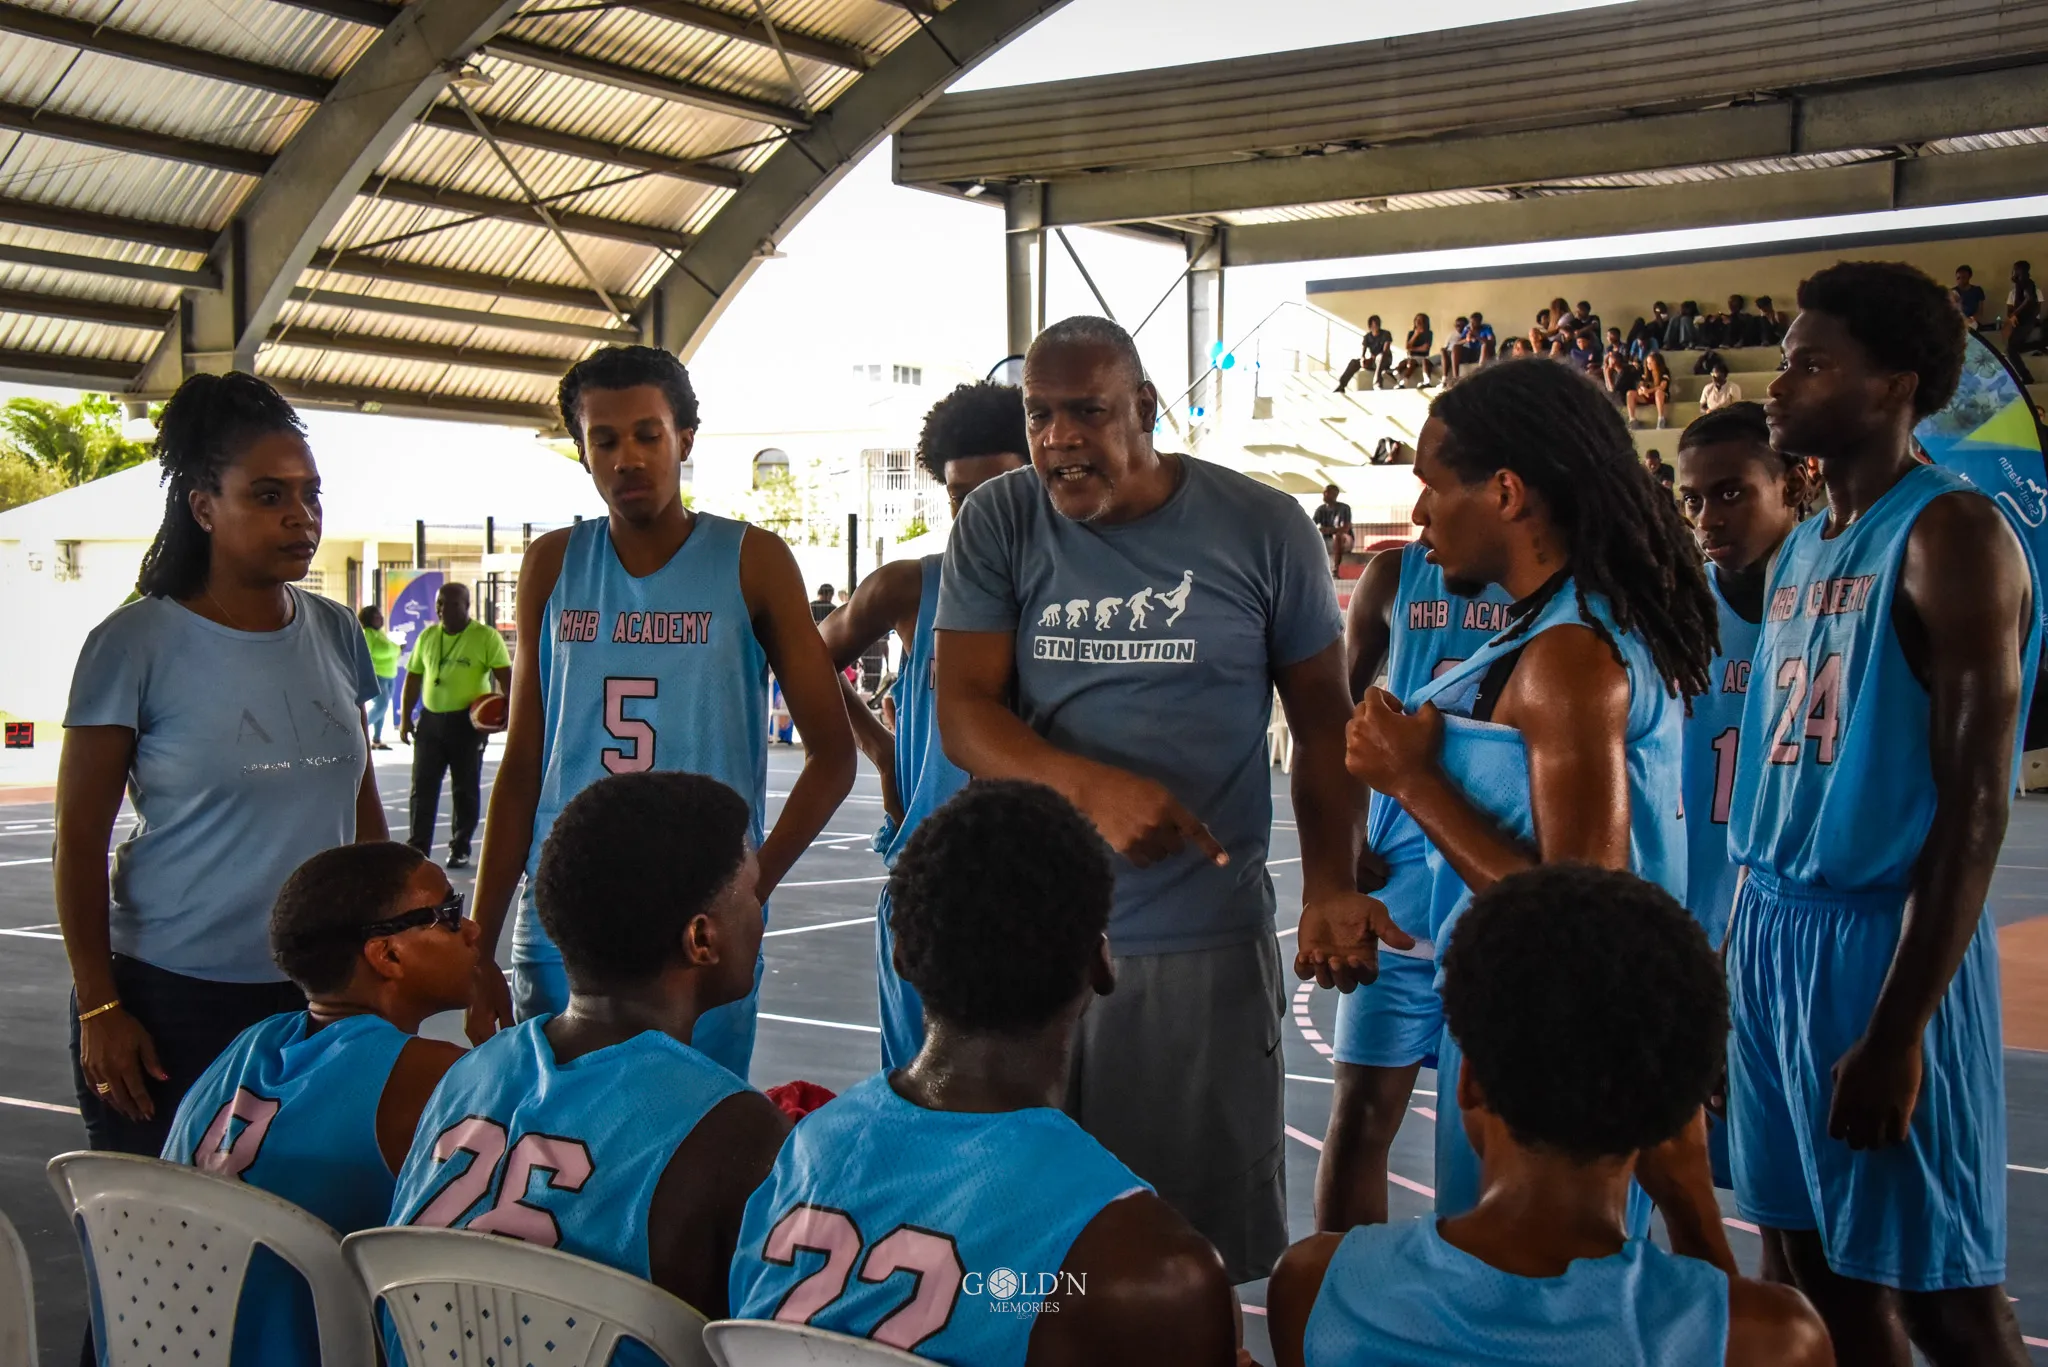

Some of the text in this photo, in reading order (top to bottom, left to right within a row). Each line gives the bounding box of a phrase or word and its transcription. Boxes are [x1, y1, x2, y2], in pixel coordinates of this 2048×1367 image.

[1409, 600, 1449, 630] MHB
[1768, 573, 1877, 623] MHB ACADEMY
[559, 610, 712, 644] MHB ACADEMY
[1034, 637, 1194, 662] 6TN EVOLUTION
[601, 676, 658, 776] 5
[1768, 652, 1842, 765] 24
[5, 723, 32, 744] 23
[761, 1202, 966, 1351] 22
